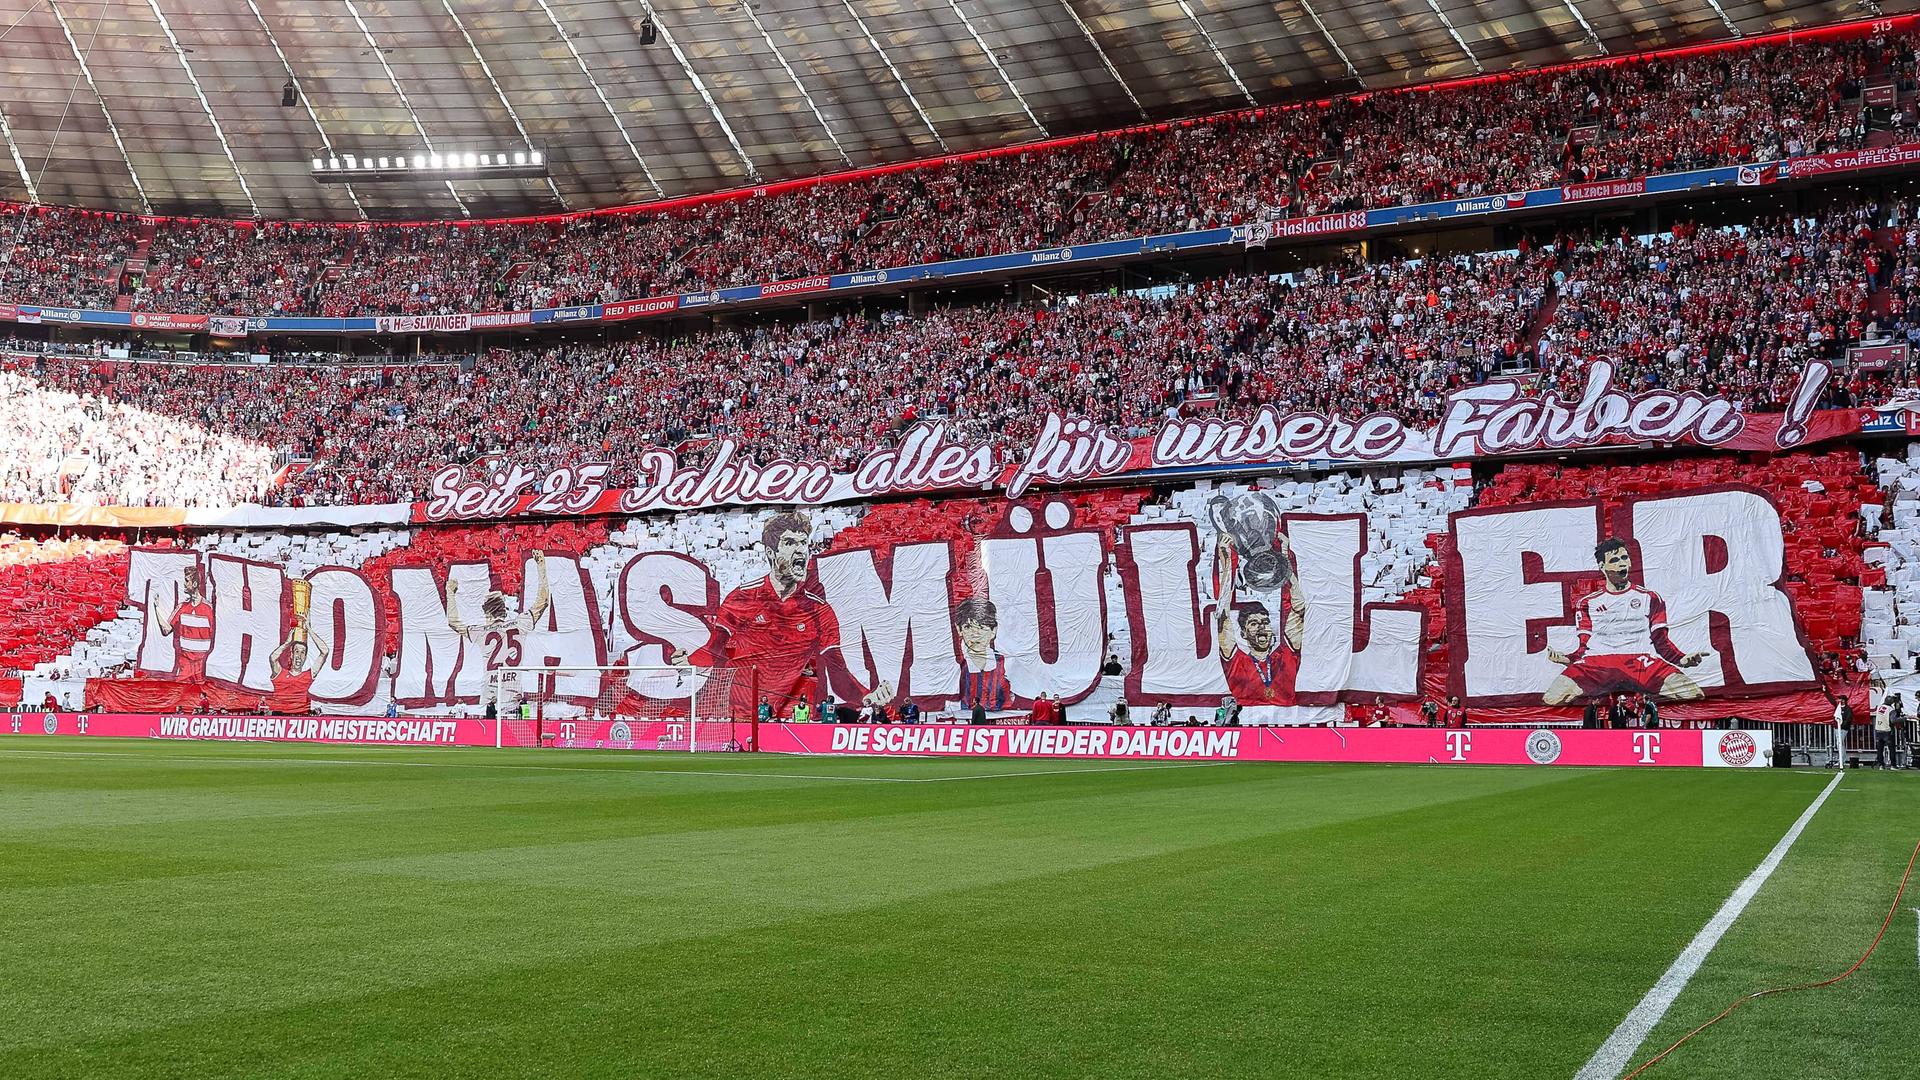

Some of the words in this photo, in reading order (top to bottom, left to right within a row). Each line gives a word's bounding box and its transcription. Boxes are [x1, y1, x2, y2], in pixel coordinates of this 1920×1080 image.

[1872, 20, 1893, 33] 313
[1877, 146, 1901, 155] BOYS
[752, 188, 767, 198] 318
[1612, 181, 1643, 195] BAZIS
[1455, 200, 1490, 212] Allianz
[141, 217, 155, 226] 321
[1275, 215, 1347, 237] Haslachtal
[1349, 211, 1366, 228] 83
[1031, 252, 1060, 263] Allianz
[761, 277, 830, 295] GROSSHEIDE
[850, 275, 877, 284] Allianz
[685, 295, 710, 304] Allianz
[40, 309, 68, 318] Allianz
[553, 310, 578, 319] Allianz
[605, 307, 624, 316] RED
[628, 300, 675, 314] RELIGION
[427, 463, 532, 521] Seit
[528, 462, 609, 513] 25
[621, 441, 832, 512] Jahren
[854, 419, 999, 494] alles
[1007, 412, 1131, 498] für
[1152, 404, 1406, 466] unsere
[1434, 355, 1744, 456] Farben
[126, 548, 718, 705] THOMAS
[818, 484, 1819, 713] MÜLLER
[485, 628, 522, 671] 25
[11, 714, 22, 733] T
[77, 714, 89, 734] T
[160, 717, 188, 736] WIR
[189, 718, 285, 738] GRATULIEREN
[288, 720, 317, 739] ZUR
[319, 720, 457, 742] MEISTERSCHAFT!
[832, 727, 869, 751] DIE
[871, 727, 962, 753] SCHALE
[966, 728, 1006, 753] IST
[1006, 729, 1107, 755] WIEDER
[1110, 730, 1240, 757] DAHOAM!
[1445, 731, 1471, 761] T
[1728, 733, 1753, 746] BAYERN
[1632, 732, 1660, 763] T
[1722, 751, 1753, 764] MÜNCHEN
